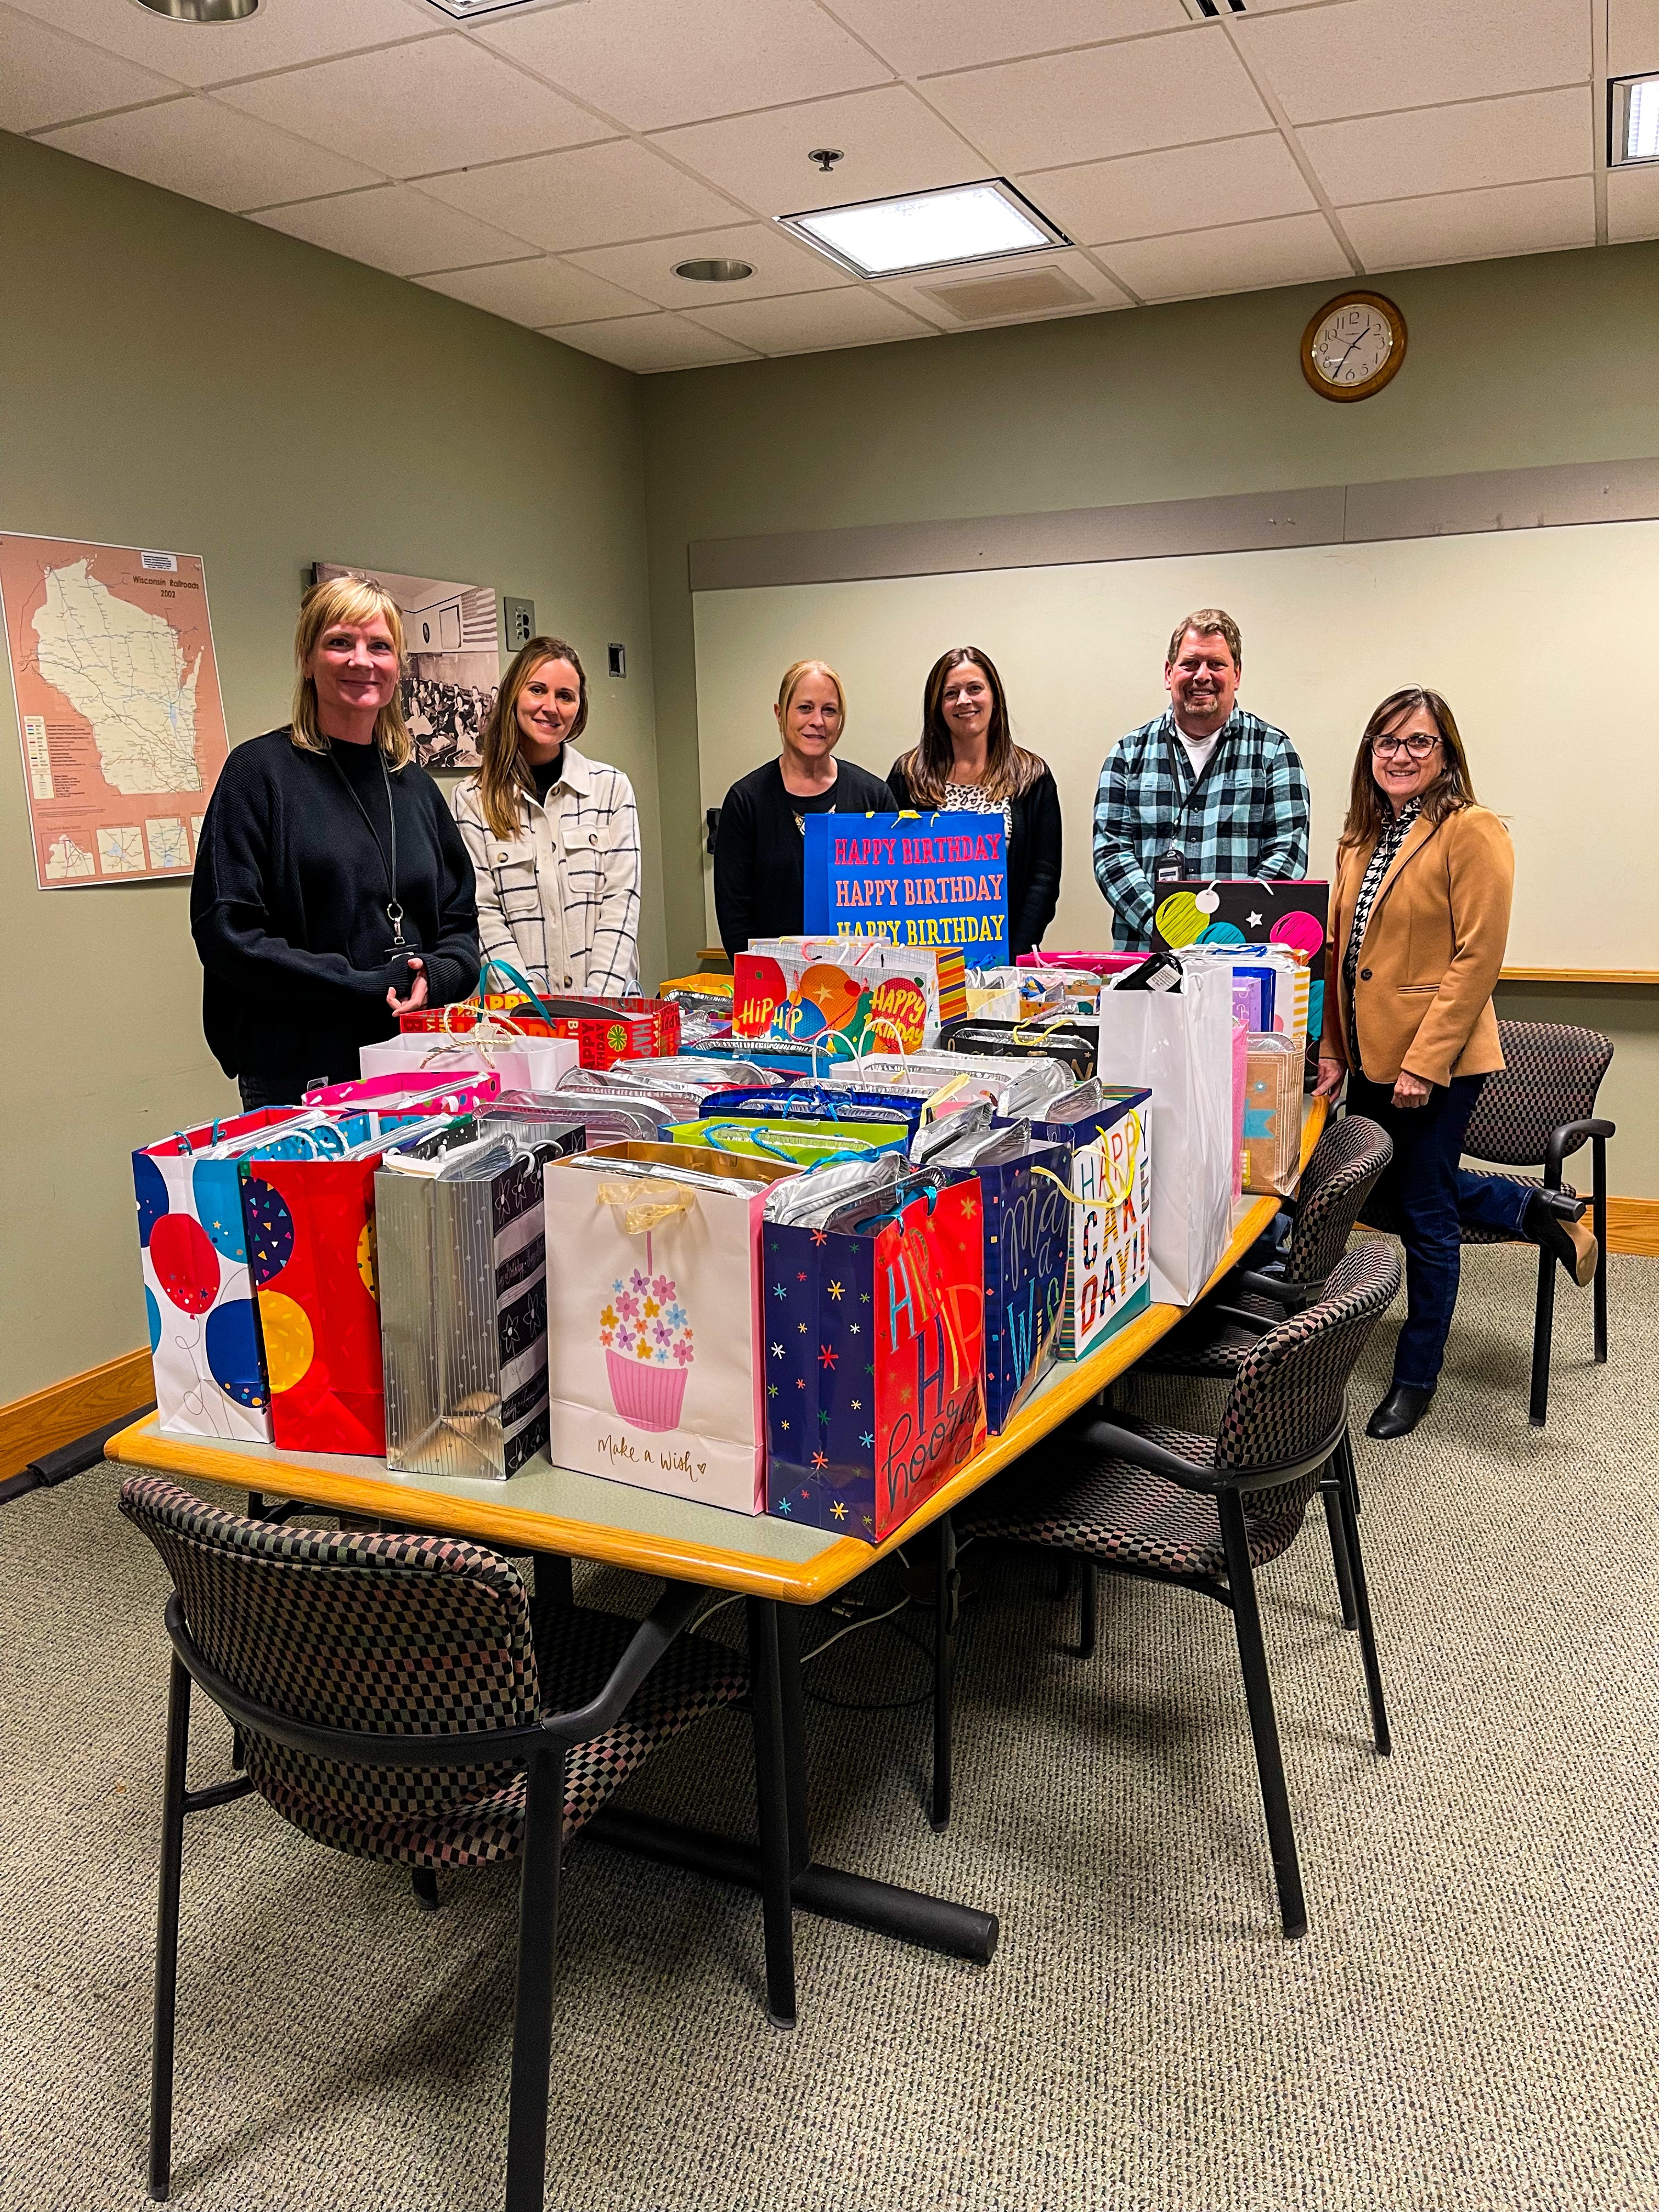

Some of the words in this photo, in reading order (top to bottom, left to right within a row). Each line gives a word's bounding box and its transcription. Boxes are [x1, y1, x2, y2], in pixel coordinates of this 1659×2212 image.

[1336, 317, 1344, 330] 11
[1349, 312, 1359, 324] 12
[1325, 329, 1337, 341] 10
[1373, 323, 1381, 336] 2
[1319, 343, 1328, 354] 9
[1376, 337, 1385, 349] 3
[1323, 357, 1331, 368] 8
[1361, 363, 1368, 376] 5
[1346, 369, 1355, 381] 6
[133, 575, 166, 586] Wisconsin
[170, 579, 199, 589] Railroads
[835, 839, 896, 865] HAPPY
[902, 833, 1001, 865] BIRTHDAY
[836, 879, 899, 907] HAPPY
[904, 874, 1003, 905] BIRTHDAY
[837, 921, 901, 946] HAPPY
[906, 915, 1005, 946] BIRTHDAY
[869, 985, 926, 1023] HAPPY
[864, 1013, 924, 1045] BIRTHDAY
[1081, 1110, 1147, 1212] HAPPY
[1082, 1156, 1150, 1270] CAKE
[1039, 1237, 1053, 1278] a
[598, 1435, 639, 1465] Make
[644, 1450, 654, 1463] a
